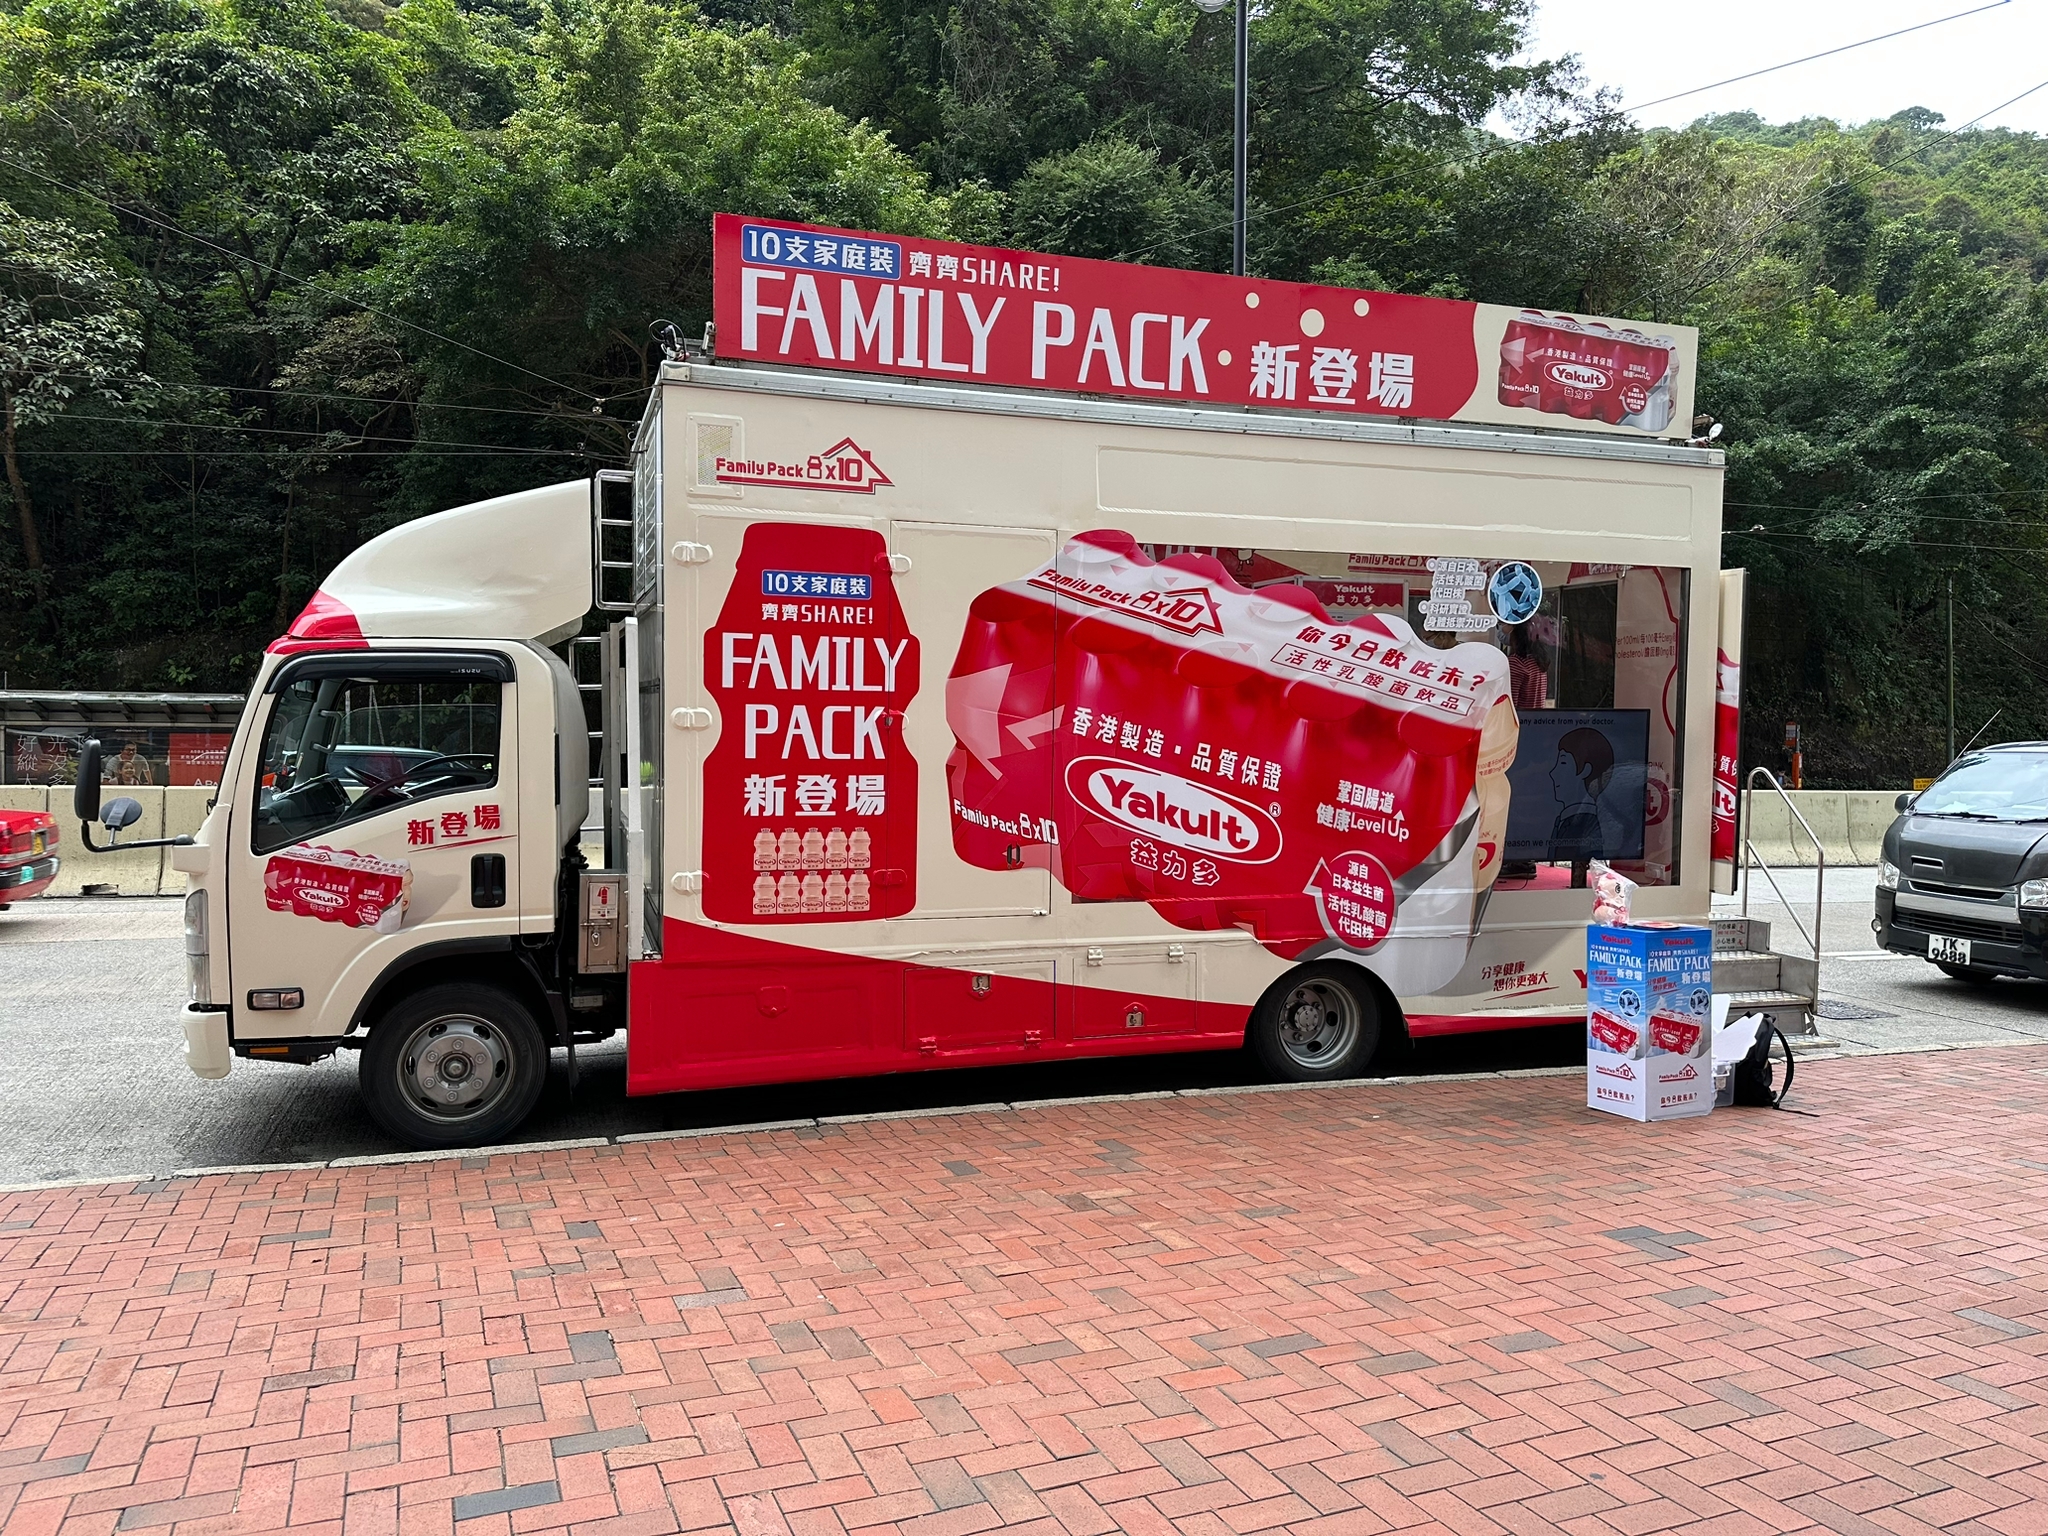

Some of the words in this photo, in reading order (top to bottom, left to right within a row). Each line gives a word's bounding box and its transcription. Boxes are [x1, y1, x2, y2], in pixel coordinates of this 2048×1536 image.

[747, 229, 895, 274] 10支家庭裝
[908, 251, 1061, 293] 齊齊SHARE!
[740, 266, 1006, 374] FAMILY
[1031, 300, 1212, 394] PACK
[1250, 341, 1414, 409] 新登場
[1556, 367, 1603, 387] Yakult
[715, 457, 765, 476] Family
[767, 461, 803, 478] Pack
[1349, 554, 1381, 567] Family
[1382, 556, 1406, 567] Pack
[1437, 561, 1477, 572] 源自日本
[766, 573, 867, 596] 10支家庭裝
[1038, 569, 1091, 592] Family
[1088, 585, 1132, 604] Pack
[1334, 584, 1375, 594] Yakult
[1435, 574, 1485, 587] 活性乳酸菌
[761, 603, 874, 624] 齊齊SHARE!
[721, 632, 908, 692] FAMILY
[1285, 650, 1459, 710] 活性乳酸菌飲品
[744, 703, 886, 760] PACK
[1519, 718, 1531, 726] any
[744, 773, 886, 817] 新登場
[1336, 780, 1395, 814] 鞏固腸道
[953, 799, 990, 828] Family
[991, 815, 1019, 835] Pack
[1098, 773, 1251, 849] Yakult
[407, 804, 500, 845] 新登場
[1505, 839, 1530, 847] reason
[1545, 838, 1589, 847] recommend
[1131, 839, 1220, 887] 益力多
[1348, 860, 1369, 880] 源自
[302, 890, 341, 905] Yakult
[1332, 873, 1384, 903] 日本益生菌
[1327, 893, 1388, 929] 活性乳酸菌
[1337, 917, 1374, 940] 代田株
[1600, 934, 1633, 945] Yakult
[1663, 938, 1695, 946] Yakult
[1941, 937, 1958, 951] TK
[1589, 950, 1618, 965] FAMILY
[1619, 954, 1642, 969] PACK
[1648, 957, 1681, 973] FAMILY
[1684, 955, 1710, 971] PACK
[1932, 947, 1967, 964] 9688
[1481, 961, 1526, 980] 分享健康
[1681, 971, 1711, 985] 新登場
[1493, 971, 1549, 992] 想你更強大
